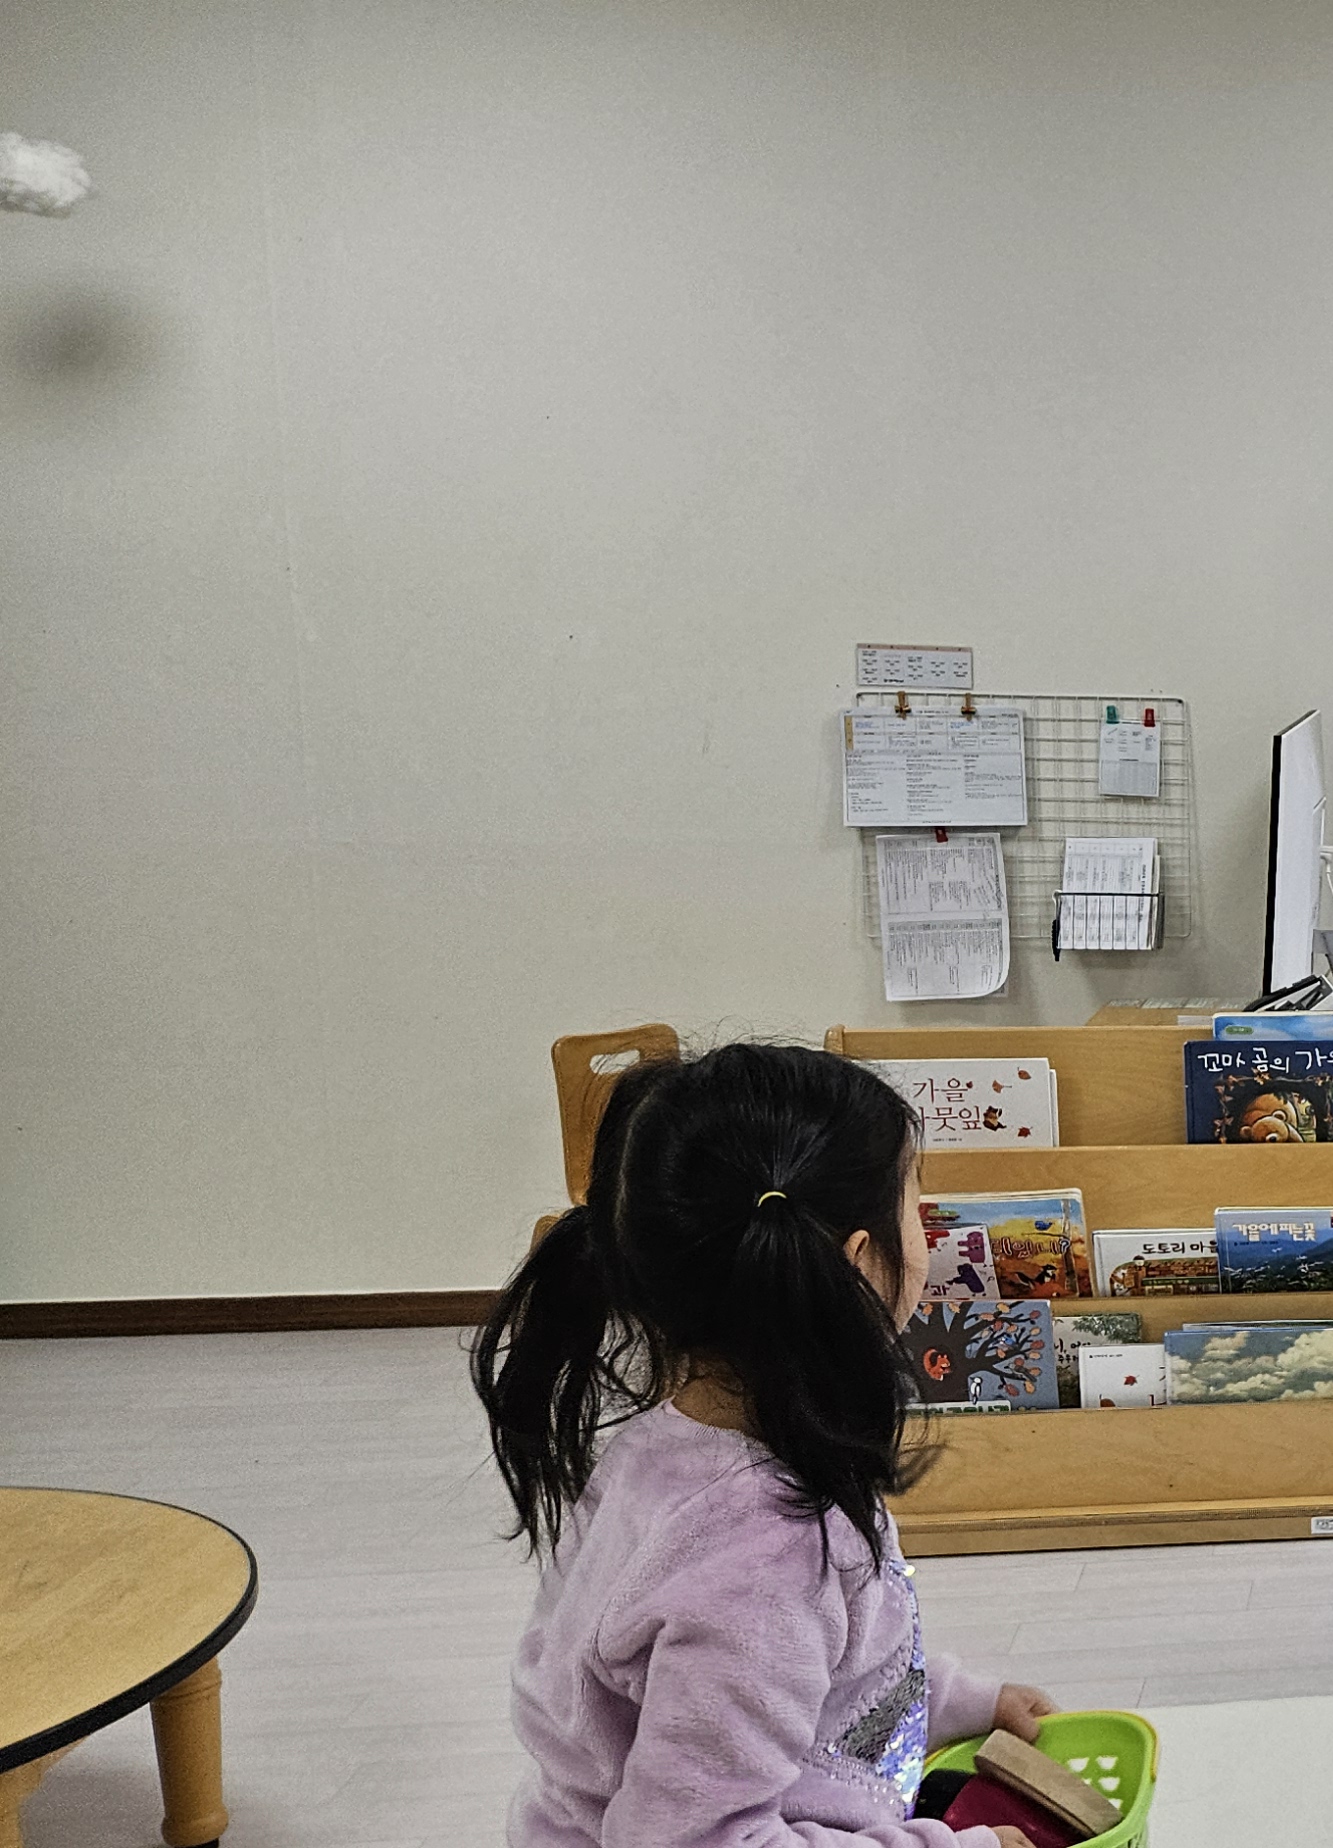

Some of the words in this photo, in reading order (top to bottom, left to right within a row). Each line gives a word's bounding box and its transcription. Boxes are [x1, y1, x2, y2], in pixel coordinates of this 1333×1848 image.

[1197, 1052, 1246, 1072] 꼬마
[1252, 1047, 1290, 1074] 곰의
[912, 1077, 969, 1104] 가을
[1232, 1222, 1279, 1242] 가을에
[1279, 1222, 1304, 1242] 피는
[1304, 1222, 1317, 1242] 꽃
[1142, 1240, 1186, 1255] 도토리
